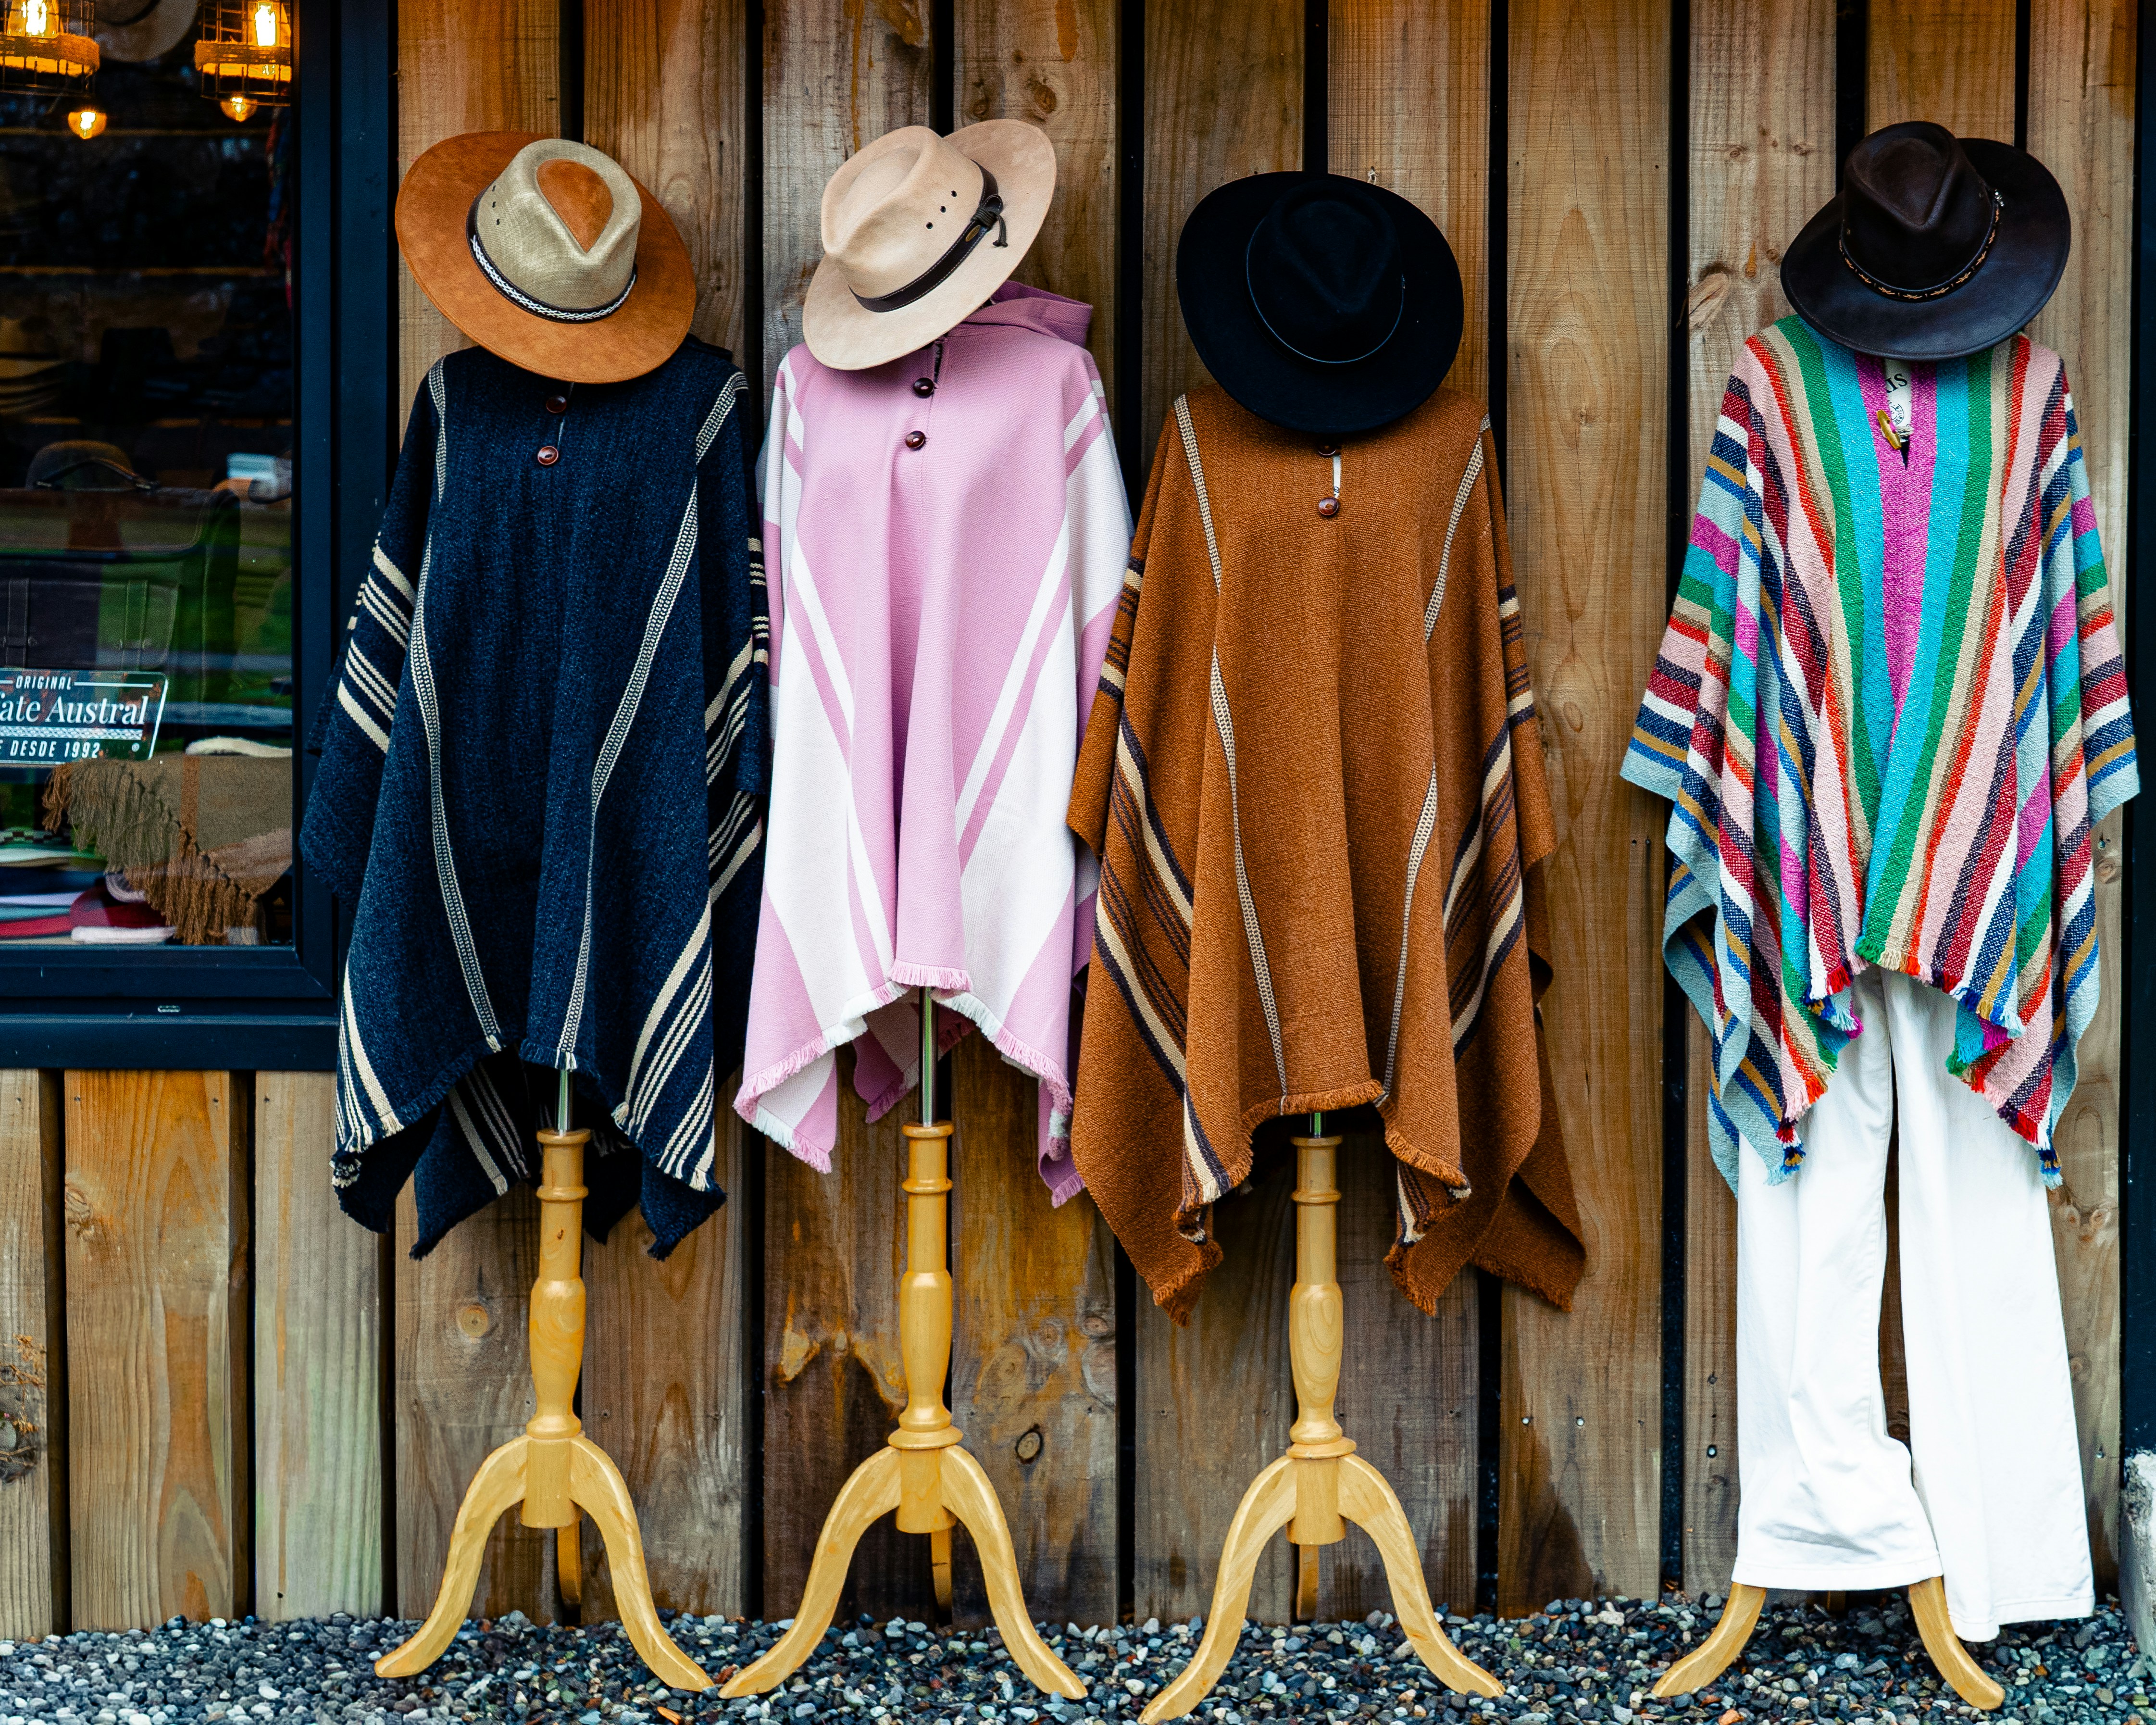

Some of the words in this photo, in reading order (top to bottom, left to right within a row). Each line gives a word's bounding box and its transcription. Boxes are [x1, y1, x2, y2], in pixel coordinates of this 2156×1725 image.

[1885, 373, 1908, 393] IS
[15, 675, 71, 690] ORIGINAL
[0, 692, 40, 722] ate
[45, 695, 149, 725] Austral
[10, 739, 57, 757] DESDE
[64, 741, 100, 759] 1992
